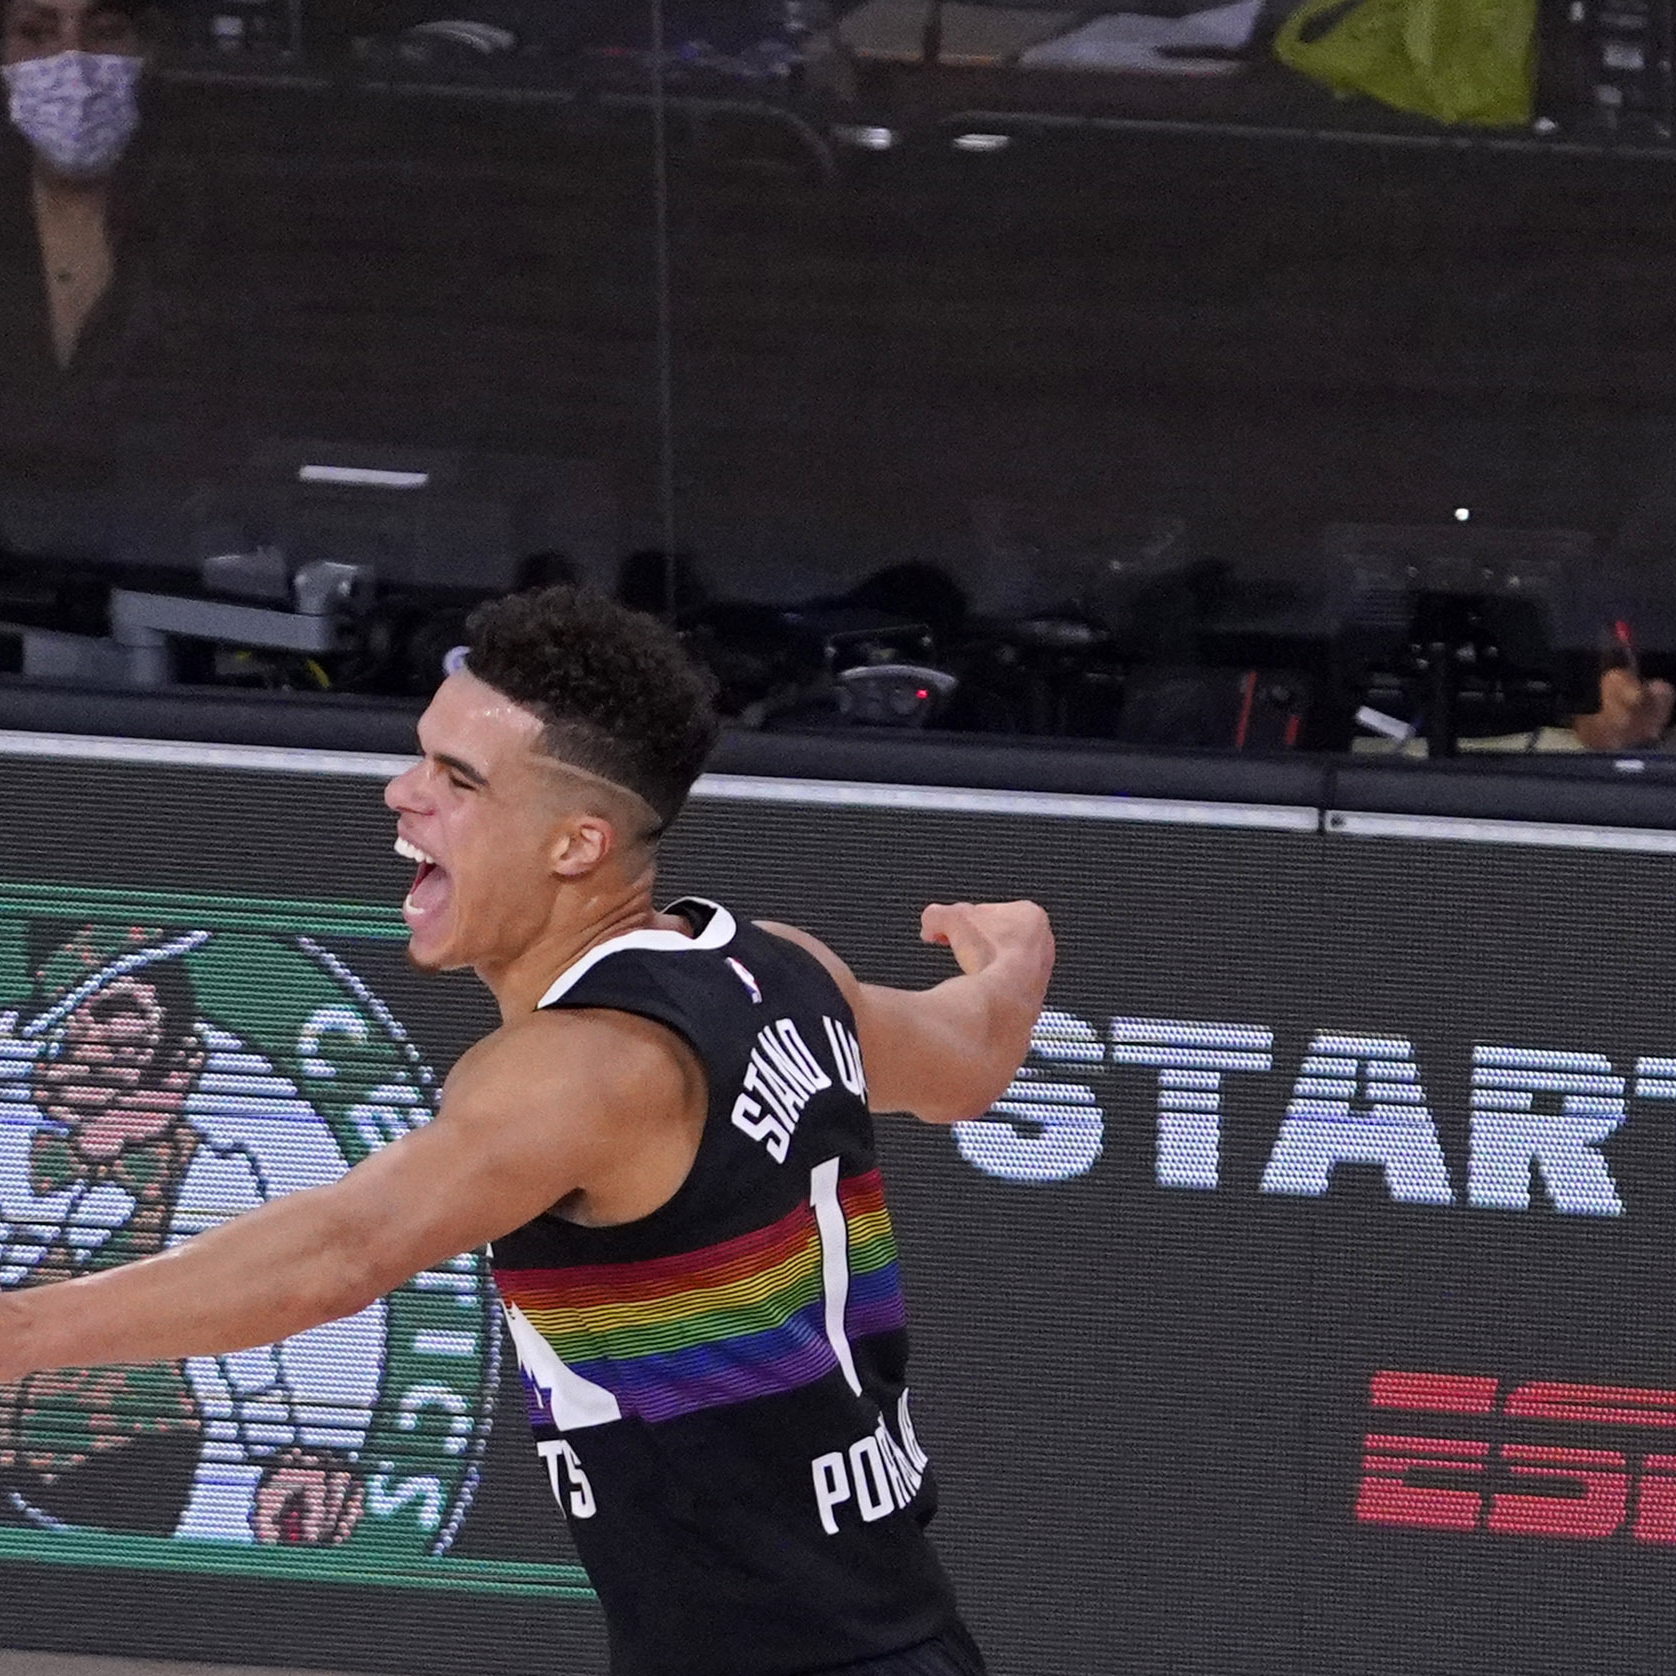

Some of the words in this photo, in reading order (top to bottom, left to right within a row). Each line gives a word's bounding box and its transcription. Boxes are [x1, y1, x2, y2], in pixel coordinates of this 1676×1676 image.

[730, 1017, 832, 1165] STAND
[299, 1003, 480, 1532] CETICS
[809, 1155, 864, 1398] 1
